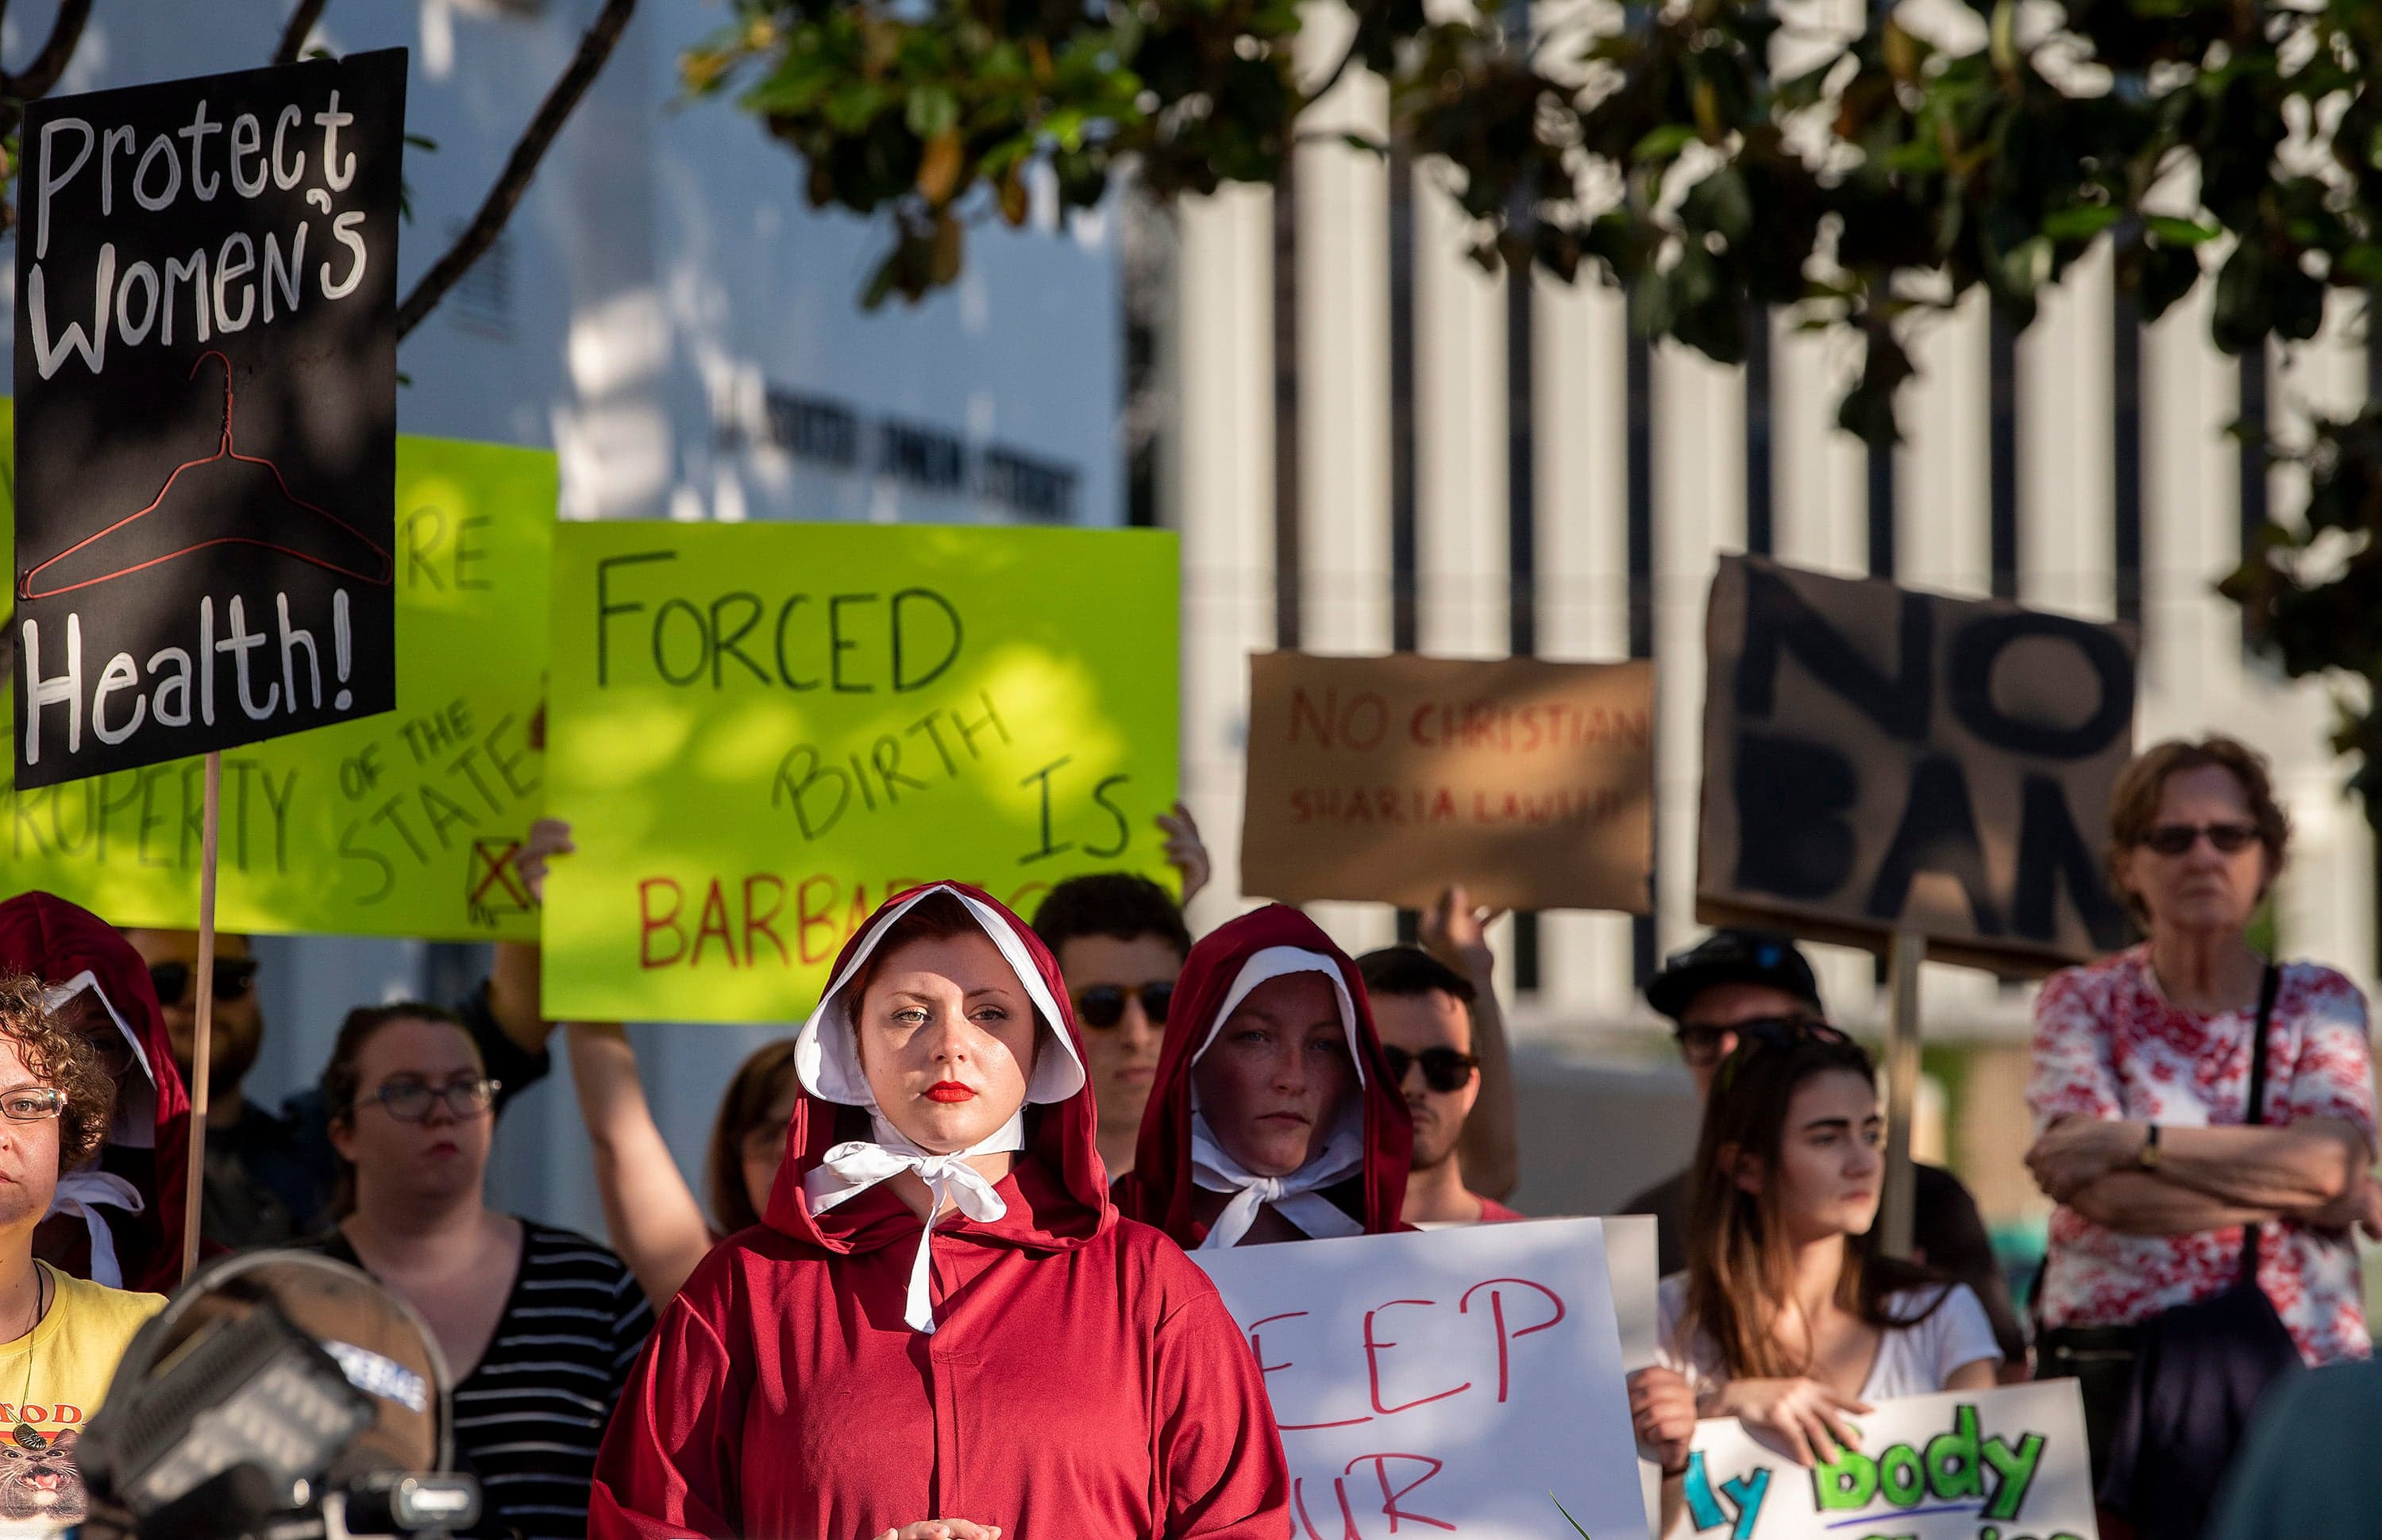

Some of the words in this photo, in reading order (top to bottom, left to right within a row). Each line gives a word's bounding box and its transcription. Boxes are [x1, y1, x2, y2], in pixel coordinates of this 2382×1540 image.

[37, 90, 357, 260] Protect
[399, 504, 496, 592] RE
[22, 588, 353, 765] Health!
[597, 550, 964, 694] FORCED
[1731, 556, 2136, 760] NO
[399, 698, 472, 764] THE
[770, 691, 1010, 841] BIRTH
[1286, 687, 1392, 751] NO
[1409, 702, 1654, 753] CHRISTIAN
[0, 758, 300, 876] ROPERTY
[337, 714, 545, 907] STATE
[1018, 756, 1131, 867] IS
[638, 872, 1050, 970] BARBA
[1247, 1278, 1566, 1431] EEP
[0, 1402, 91, 1426] TOD
[1815, 1404, 2046, 1521] body
[1290, 1452, 1458, 1540] UR
